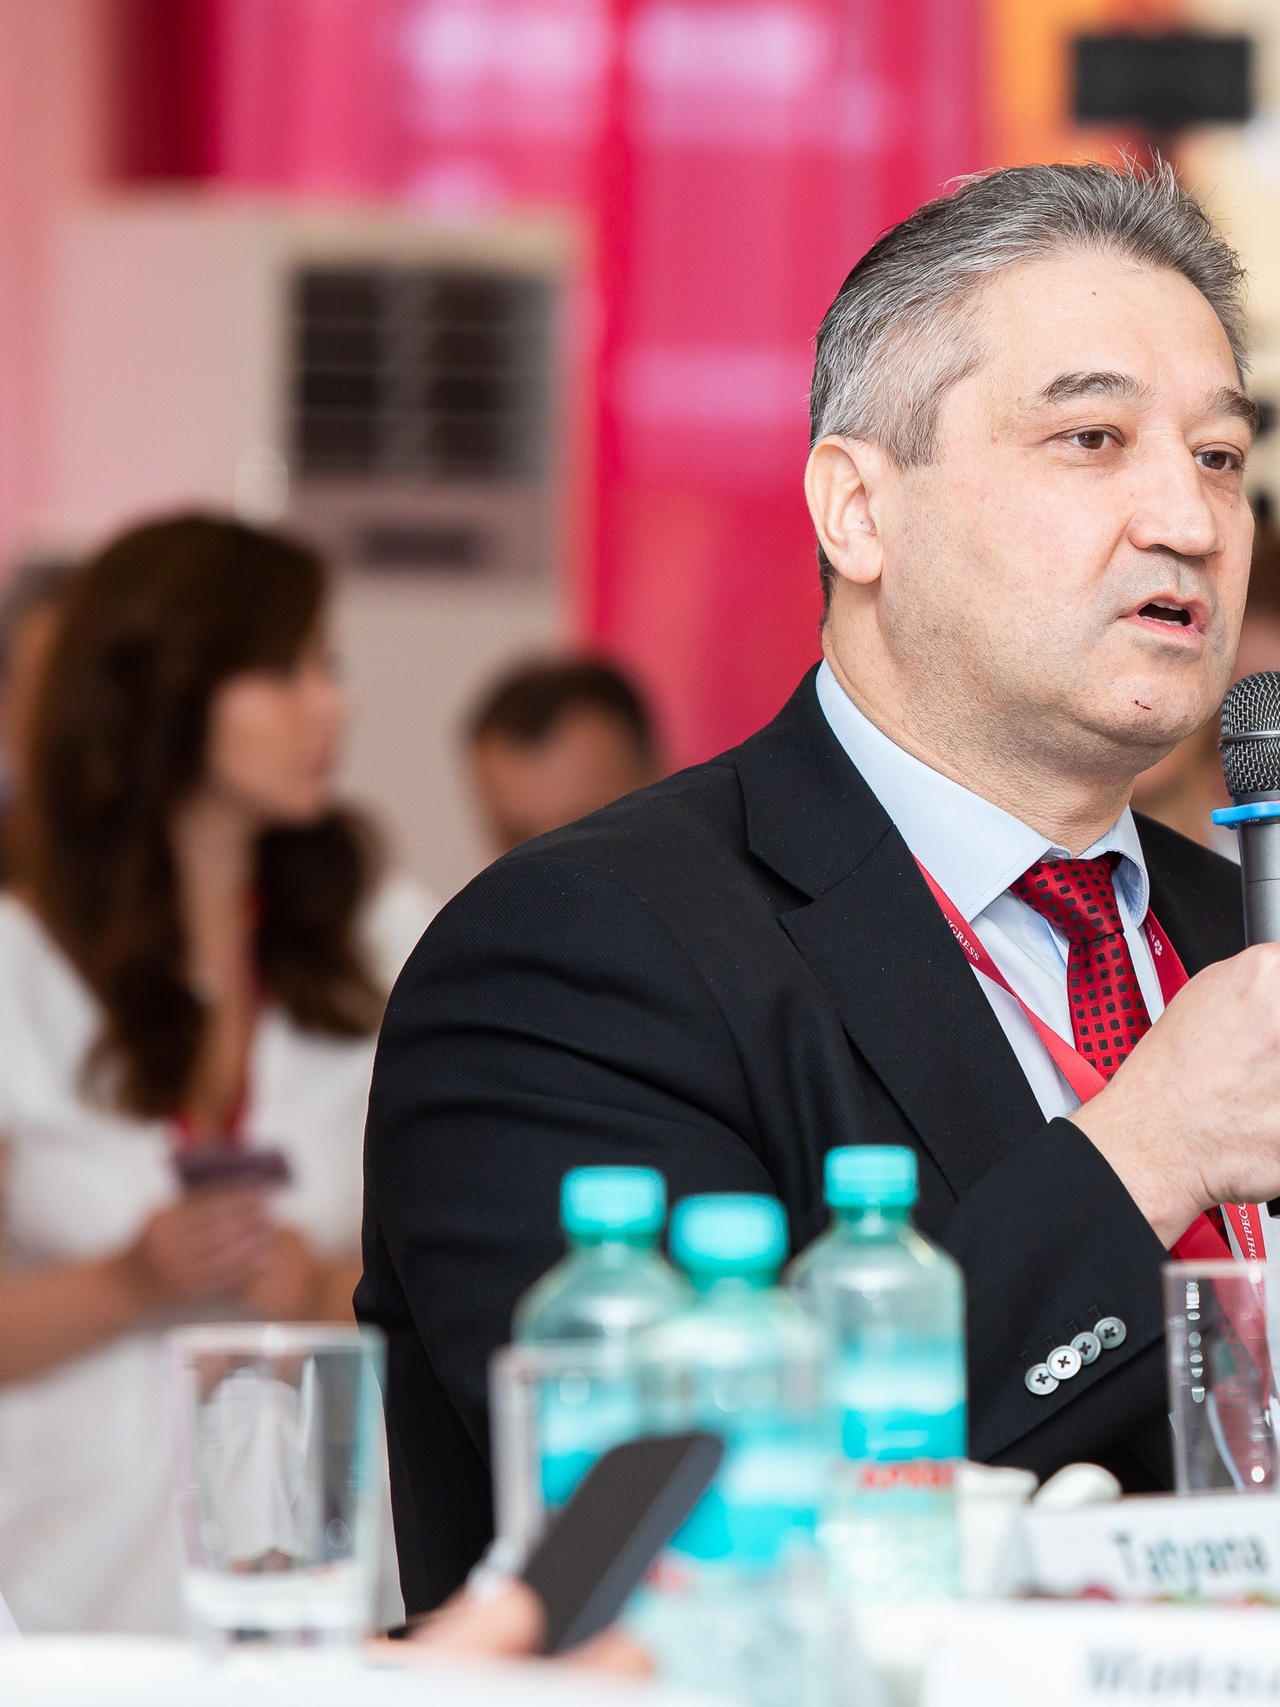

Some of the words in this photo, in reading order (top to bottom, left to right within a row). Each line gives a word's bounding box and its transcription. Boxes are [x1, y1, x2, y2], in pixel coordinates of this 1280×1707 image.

[943, 912, 980, 961] GRESS
[1237, 1202, 1258, 1264] ОНГРЕСС
[1112, 1529, 1269, 1592] Tatyana
